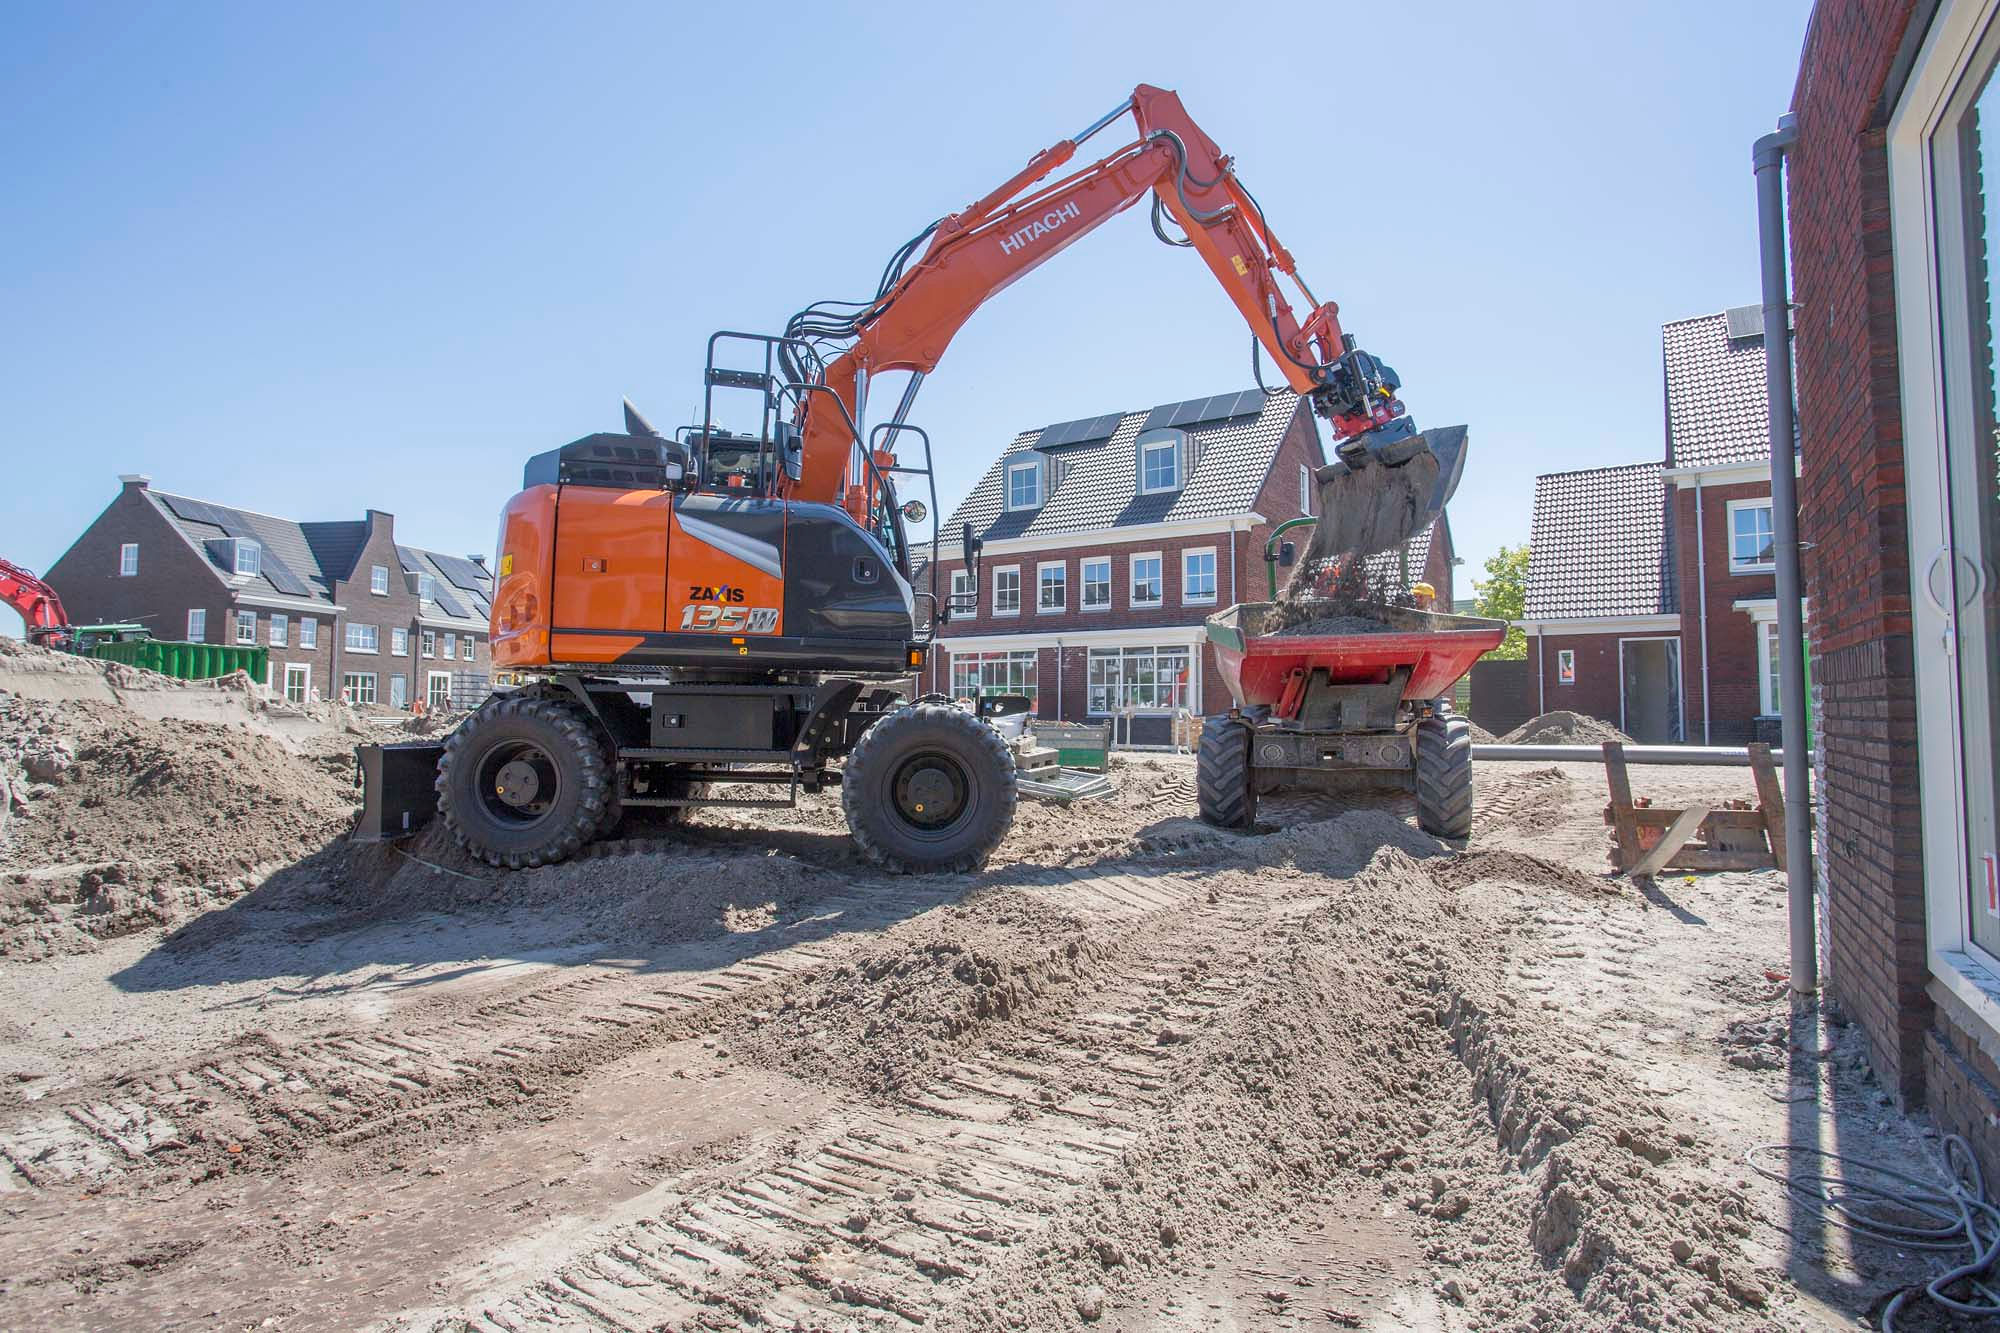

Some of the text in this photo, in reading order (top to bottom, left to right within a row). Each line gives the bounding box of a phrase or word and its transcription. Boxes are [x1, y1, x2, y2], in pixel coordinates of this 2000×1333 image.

[1000, 201, 1080, 255] HITACHI
[689, 584, 745, 603] ZAXIS
[680, 604, 779, 633] 135W
